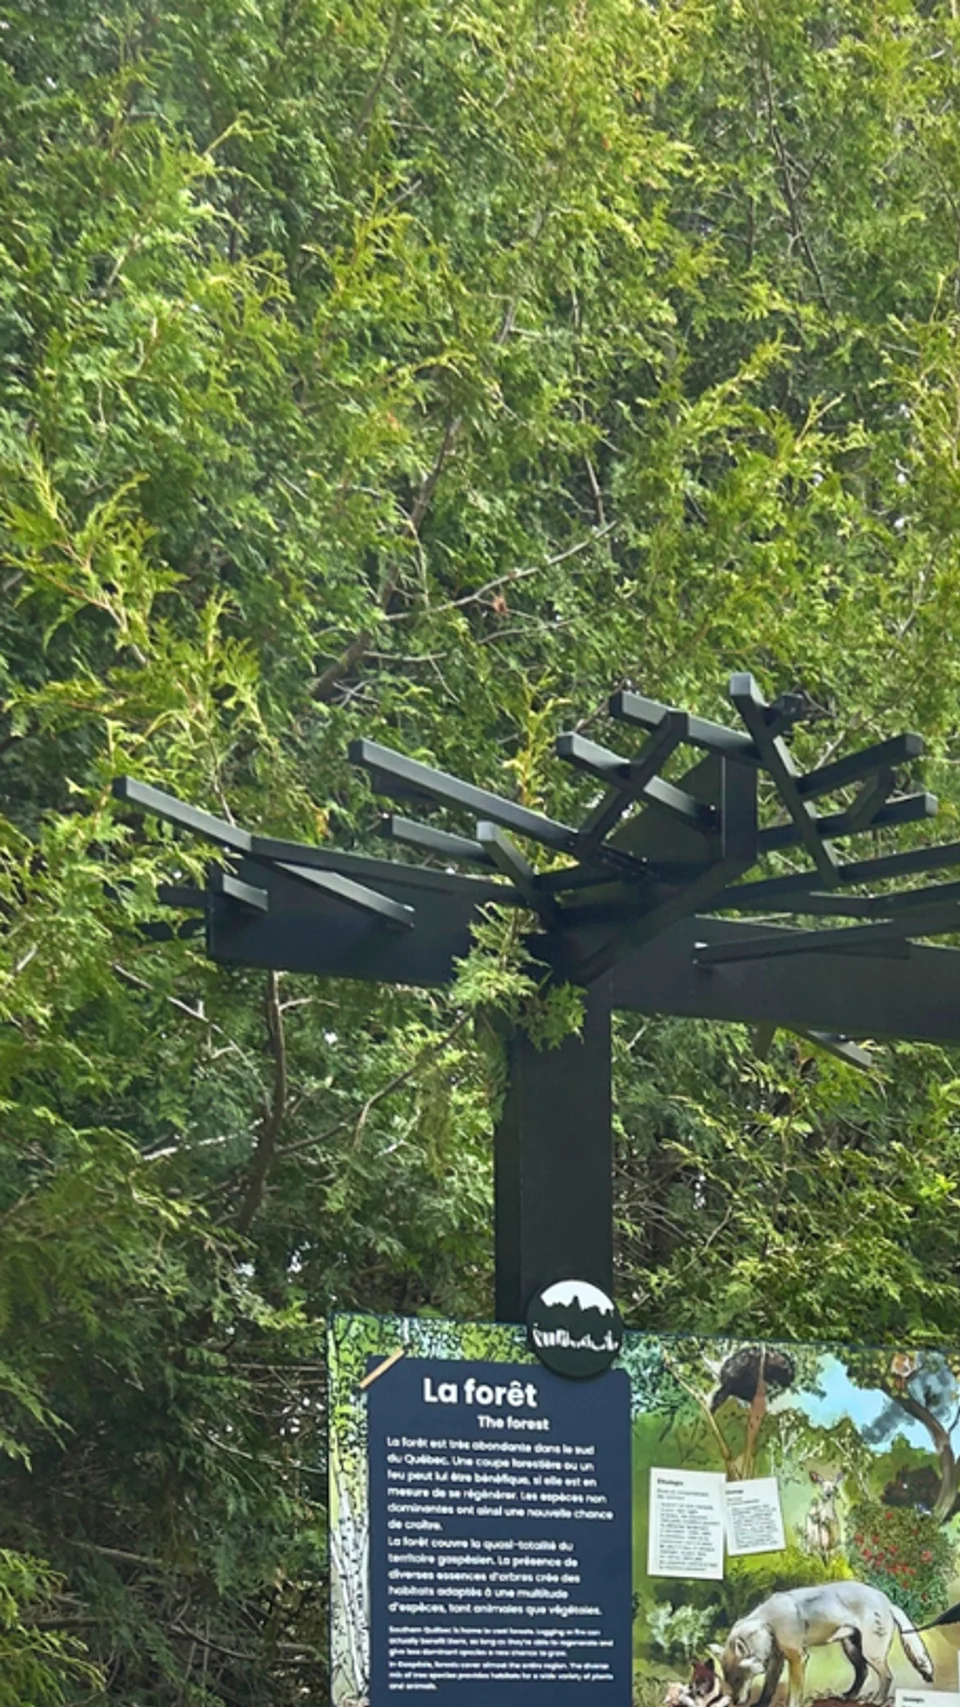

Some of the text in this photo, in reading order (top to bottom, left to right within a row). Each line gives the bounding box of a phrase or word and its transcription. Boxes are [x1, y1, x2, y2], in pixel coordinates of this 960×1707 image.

[424, 1377, 538, 1408] La forêt
[477, 1414, 550, 1431] The forest
[387, 1436, 595, 1455] La forêt est très abondante dans le sud
[387, 1453, 595, 1472] du Québec. Une coupe forestière ou un
